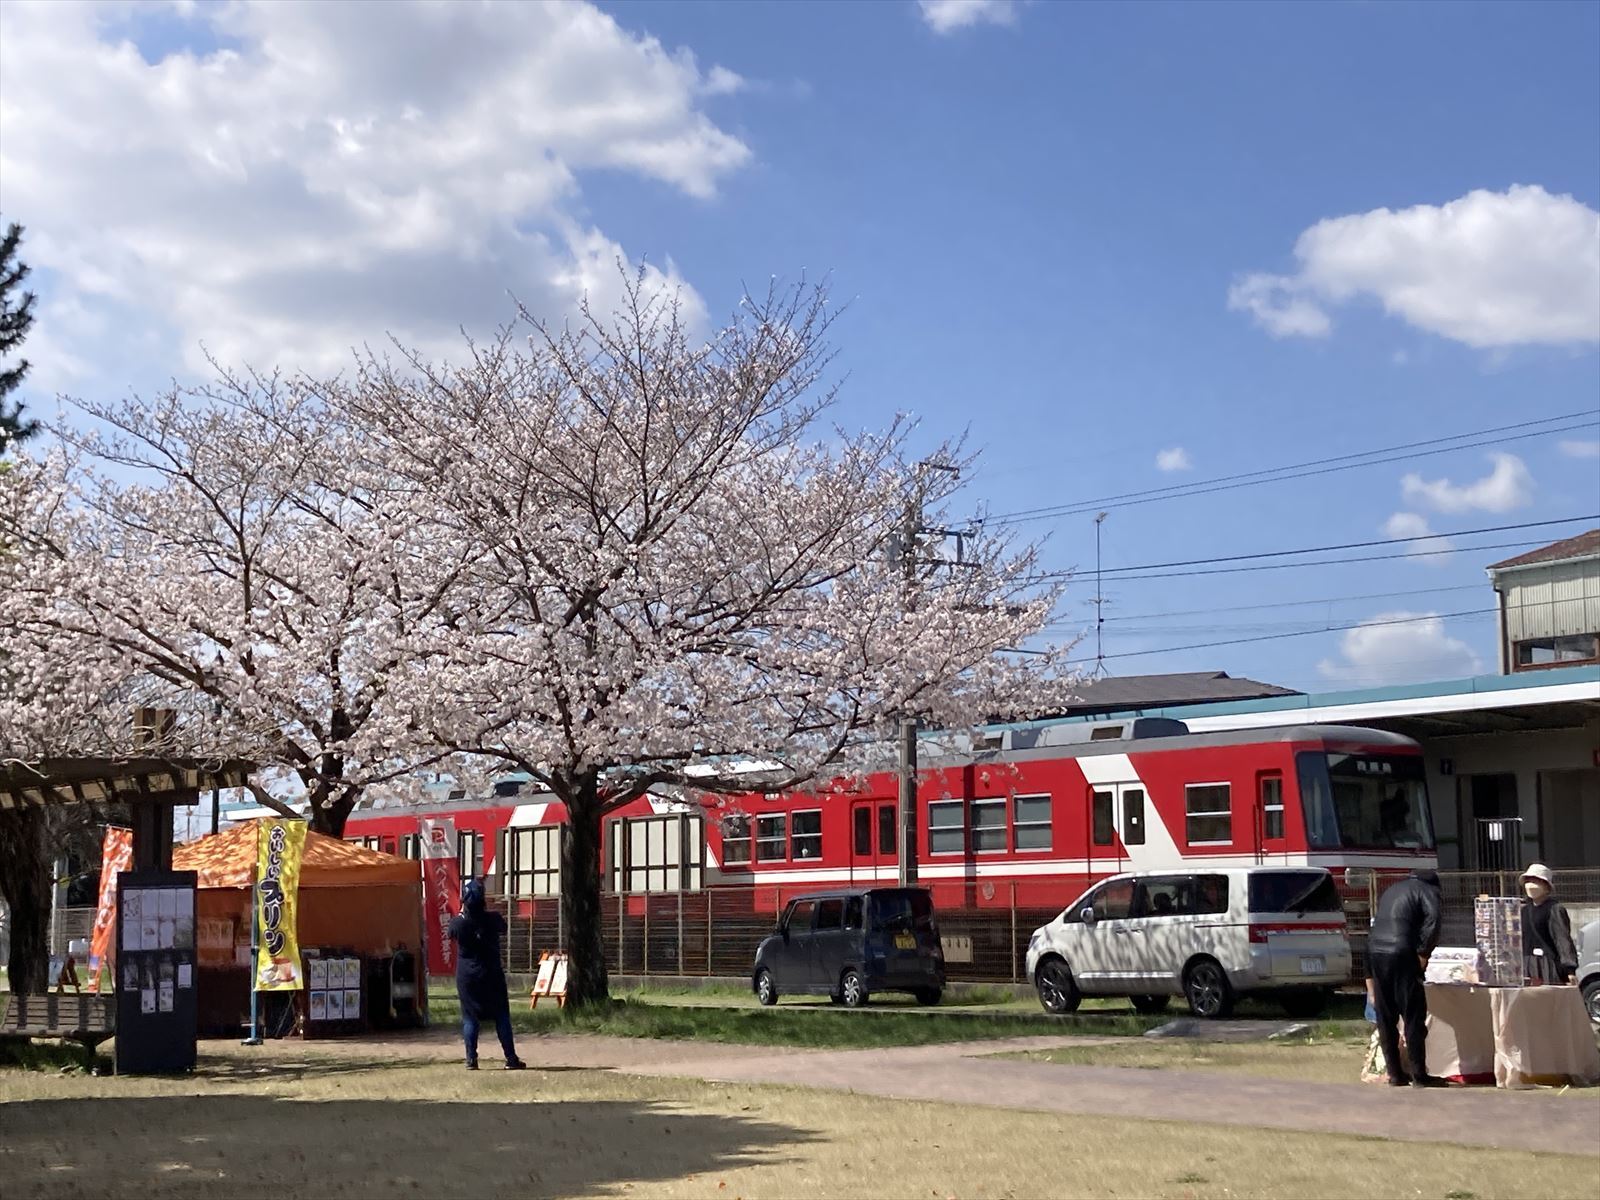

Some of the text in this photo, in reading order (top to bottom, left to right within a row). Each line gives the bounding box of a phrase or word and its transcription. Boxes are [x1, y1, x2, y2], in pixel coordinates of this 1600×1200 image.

[260, 825, 285, 957] おいしいプリン
